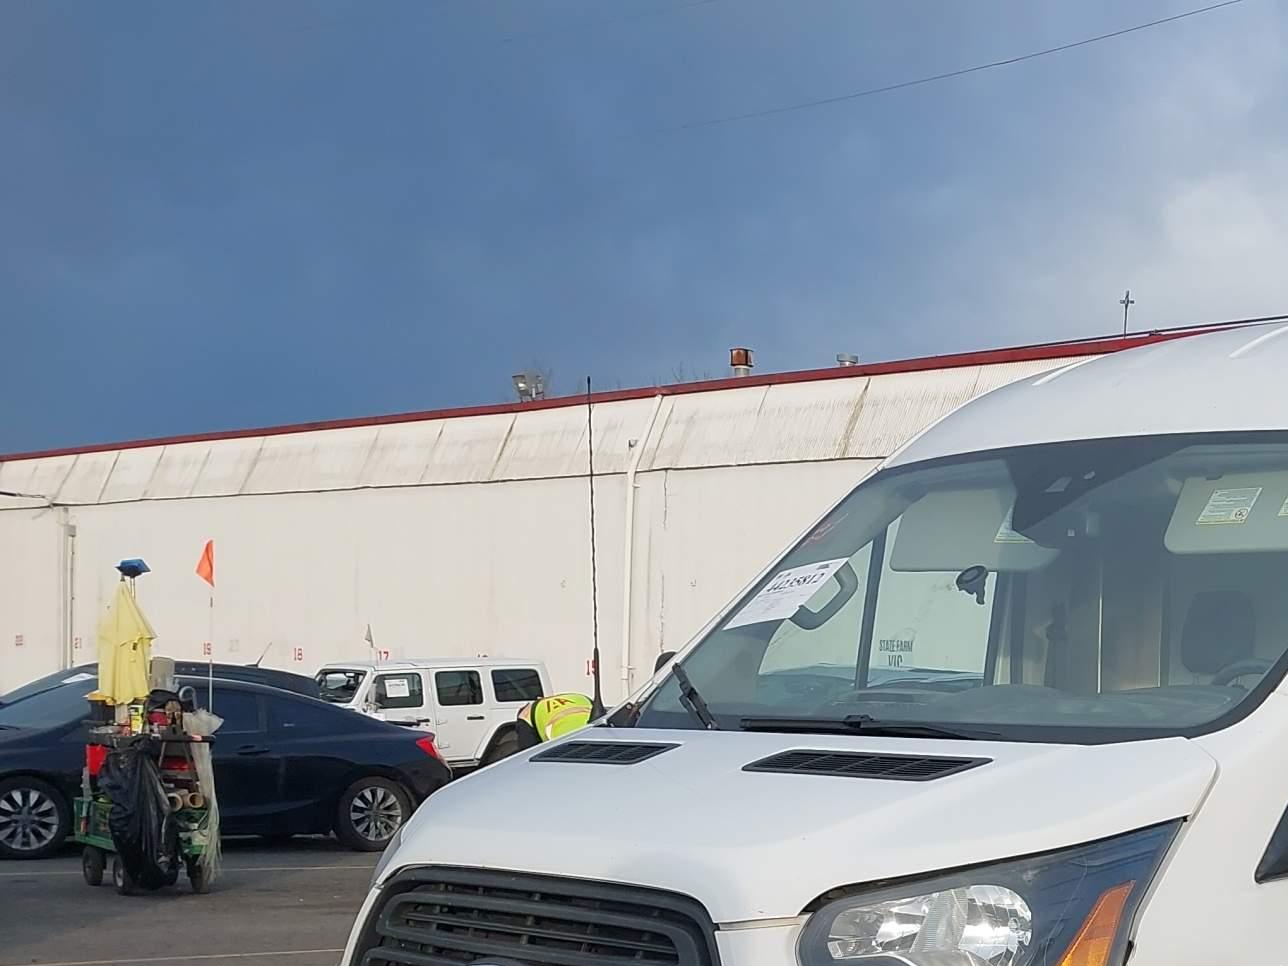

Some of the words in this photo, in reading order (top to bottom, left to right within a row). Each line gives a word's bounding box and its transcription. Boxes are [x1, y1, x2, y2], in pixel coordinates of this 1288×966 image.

[879, 639, 896, 652] STATE
[896, 639, 913, 653] FARM
[294, 647, 303, 661] 18
[378, 650, 389, 661] 17
